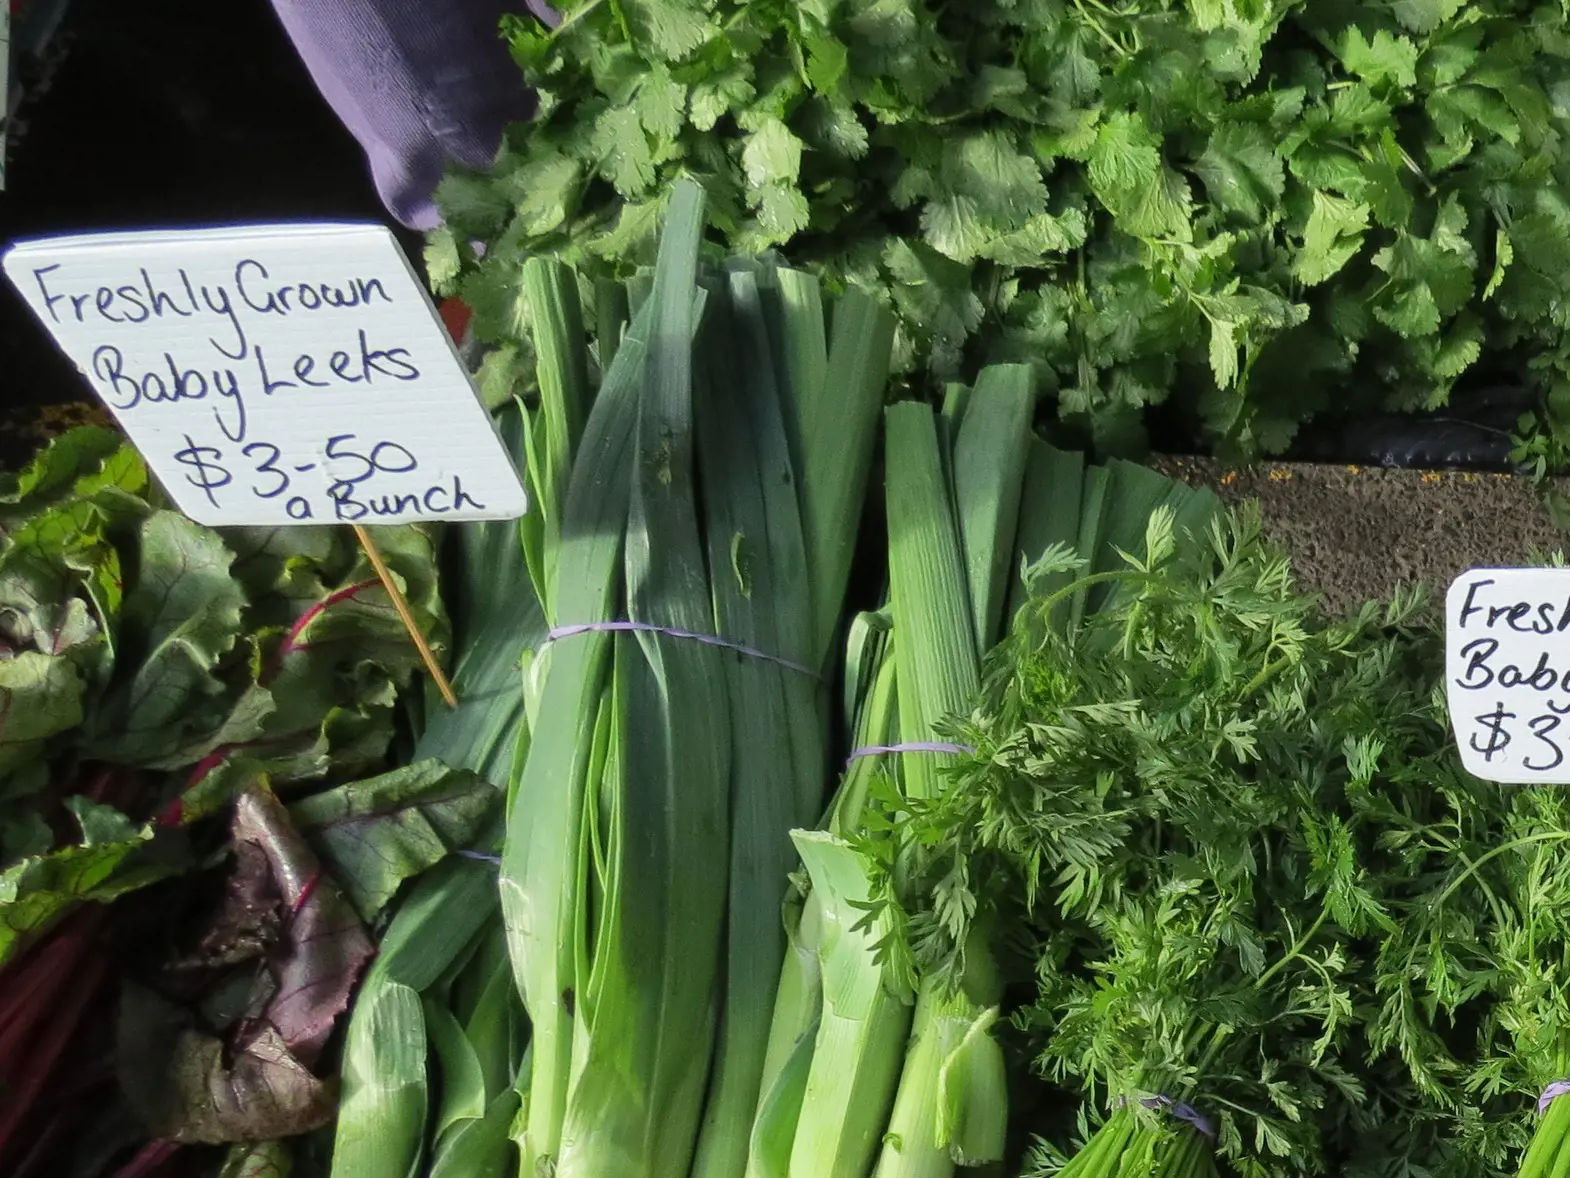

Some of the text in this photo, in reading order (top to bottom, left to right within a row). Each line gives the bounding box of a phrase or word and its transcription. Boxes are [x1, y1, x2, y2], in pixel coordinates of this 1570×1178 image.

[33, 259, 394, 361] Freshly Grown
[92, 328, 421, 443] Baby Leeks
[285, 475, 487, 522] a Bunch
